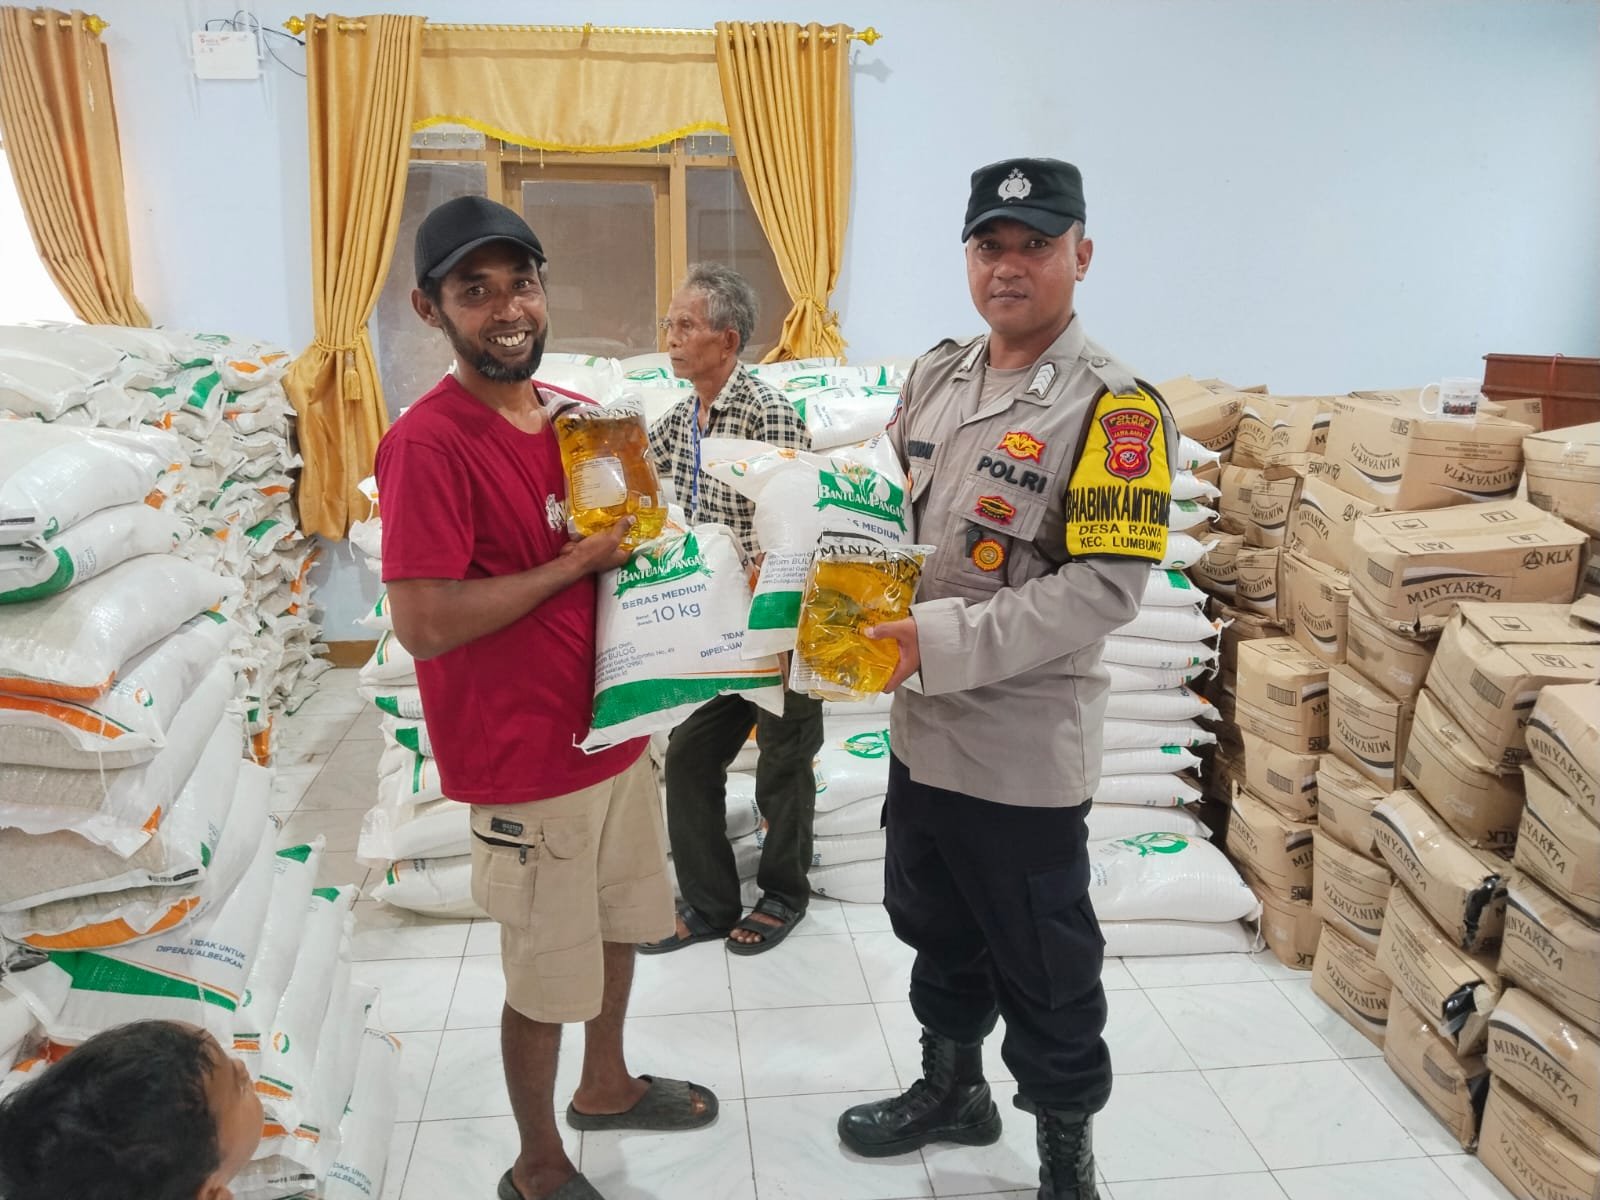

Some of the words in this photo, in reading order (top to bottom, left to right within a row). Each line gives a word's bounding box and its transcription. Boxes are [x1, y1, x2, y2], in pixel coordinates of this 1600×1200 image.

[1351, 442, 1400, 470] MINYAKITA
[977, 455, 1047, 493] POLRI
[1444, 463, 1519, 487] MINYAKITA
[817, 485, 867, 505] BANTUAN
[862, 522, 900, 542] MEDIUM
[1079, 523, 1120, 535] DESA
[1129, 525, 1162, 538] RAWA
[1080, 536, 1106, 549] KEC.
[1113, 536, 1162, 553] LUMBUNG
[1545, 549, 1574, 565] KLK
[617, 566, 665, 586] BANTUAN
[622, 594, 659, 610] BERAS
[661, 583, 707, 601] MEDIUM
[1407, 580, 1502, 605] MINYAKITA
[652, 606, 674, 623] 10
[678, 602, 701, 618] kg
[721, 630, 744, 641] TIDAK
[608, 646, 637, 660] BULOG
[1336, 717, 1391, 753] MINYAKITA
[1530, 737, 1596, 807] MINYAKITA
[1323, 881, 1385, 920] MINYAKITA
[190, 938, 217, 949] TIDAK
[218, 944, 246, 960] UNTUK
[1326, 960, 1389, 1009] MINYAKITA
[1493, 1039, 1579, 1107] MINYAKITA
